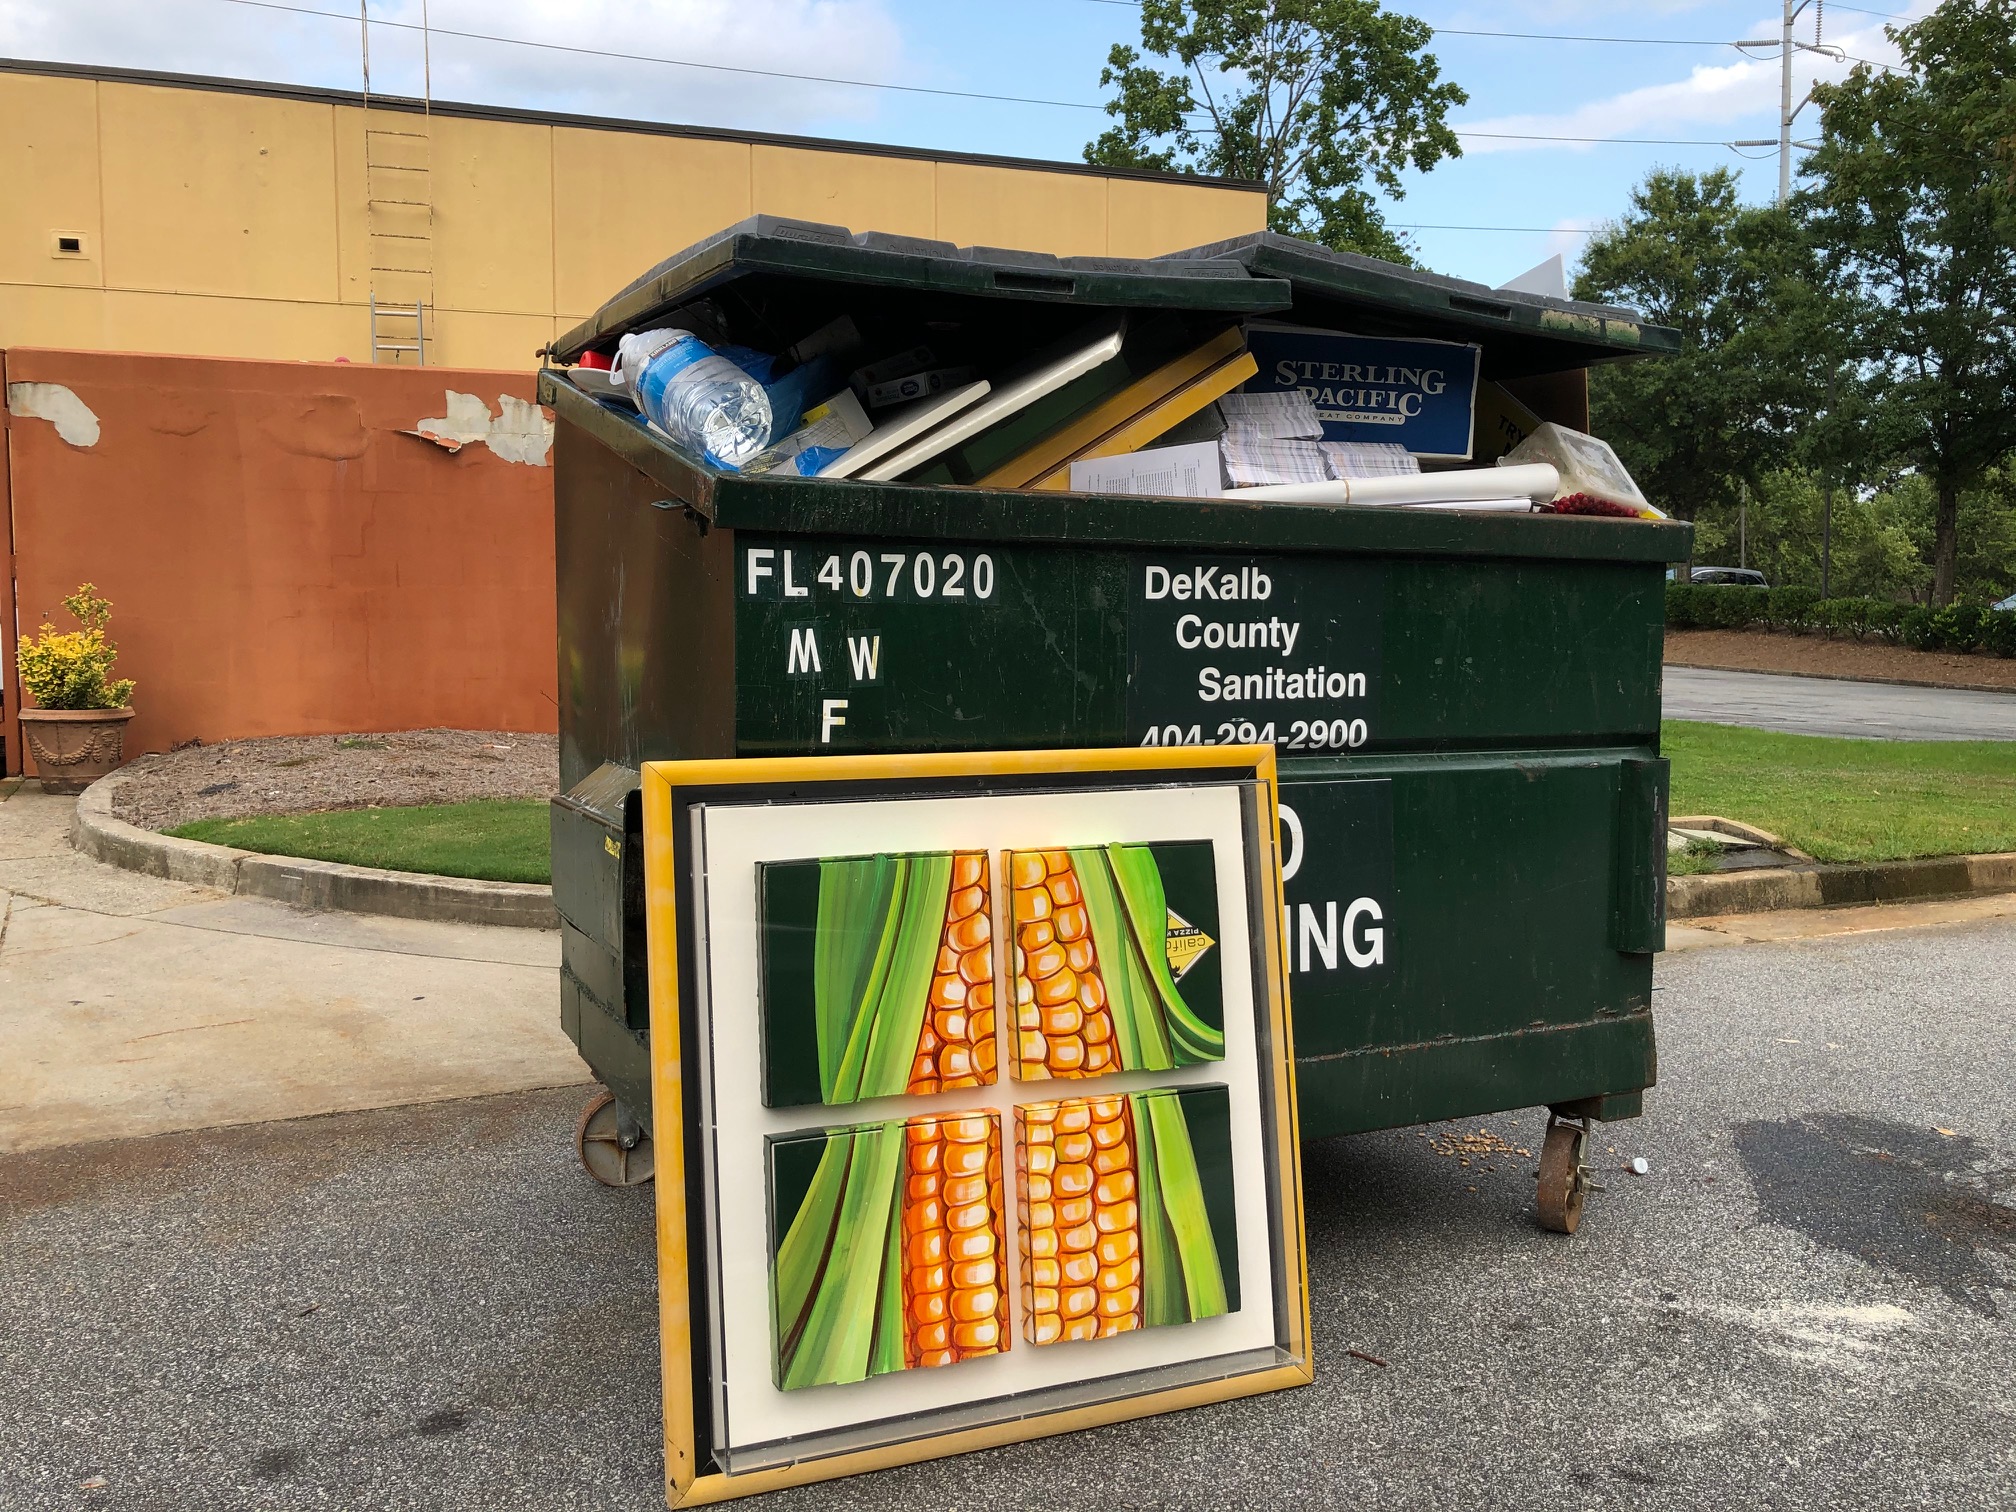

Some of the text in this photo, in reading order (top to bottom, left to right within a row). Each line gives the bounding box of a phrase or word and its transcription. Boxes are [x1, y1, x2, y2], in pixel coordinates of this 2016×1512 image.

[1275, 360, 1447, 395] STERLING
[1297, 385, 1423, 417] PACIFIC
[1314, 411, 1403, 422] EAT COMPANY
[1145, 565, 1272, 600] DeKalb
[1176, 614, 1300, 656] County
[788, 628, 880, 681] M W
[1198, 665, 1366, 702] Sanitation
[821, 699, 848, 743] F
[1140, 718, 1368, 750] 404-294-2900
[1173, 928, 1199, 936] PIZZA
